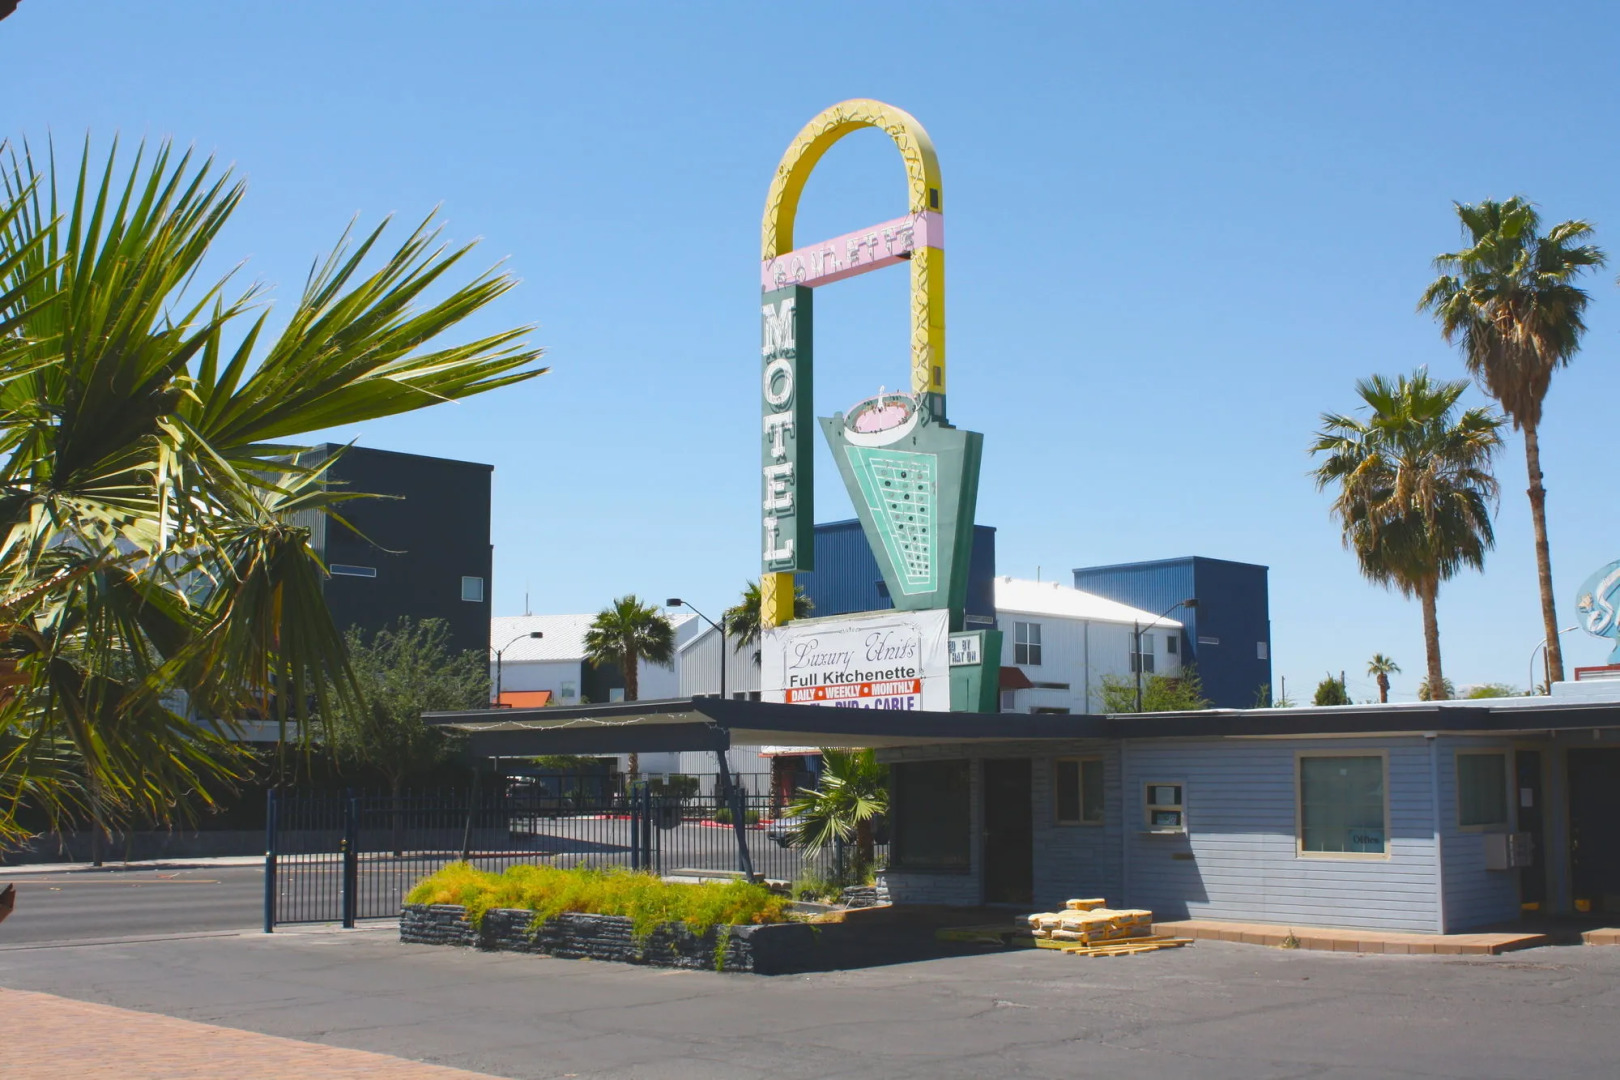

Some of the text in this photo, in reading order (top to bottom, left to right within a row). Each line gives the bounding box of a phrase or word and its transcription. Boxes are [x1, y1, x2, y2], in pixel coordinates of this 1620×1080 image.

[762, 297, 795, 563] MOTEL
[790, 631, 917, 673] Luxury Units
[790, 666, 916, 687] Full Kitchenette
[791, 680, 915, 702] DAILY WEEKLY MONTHLY
